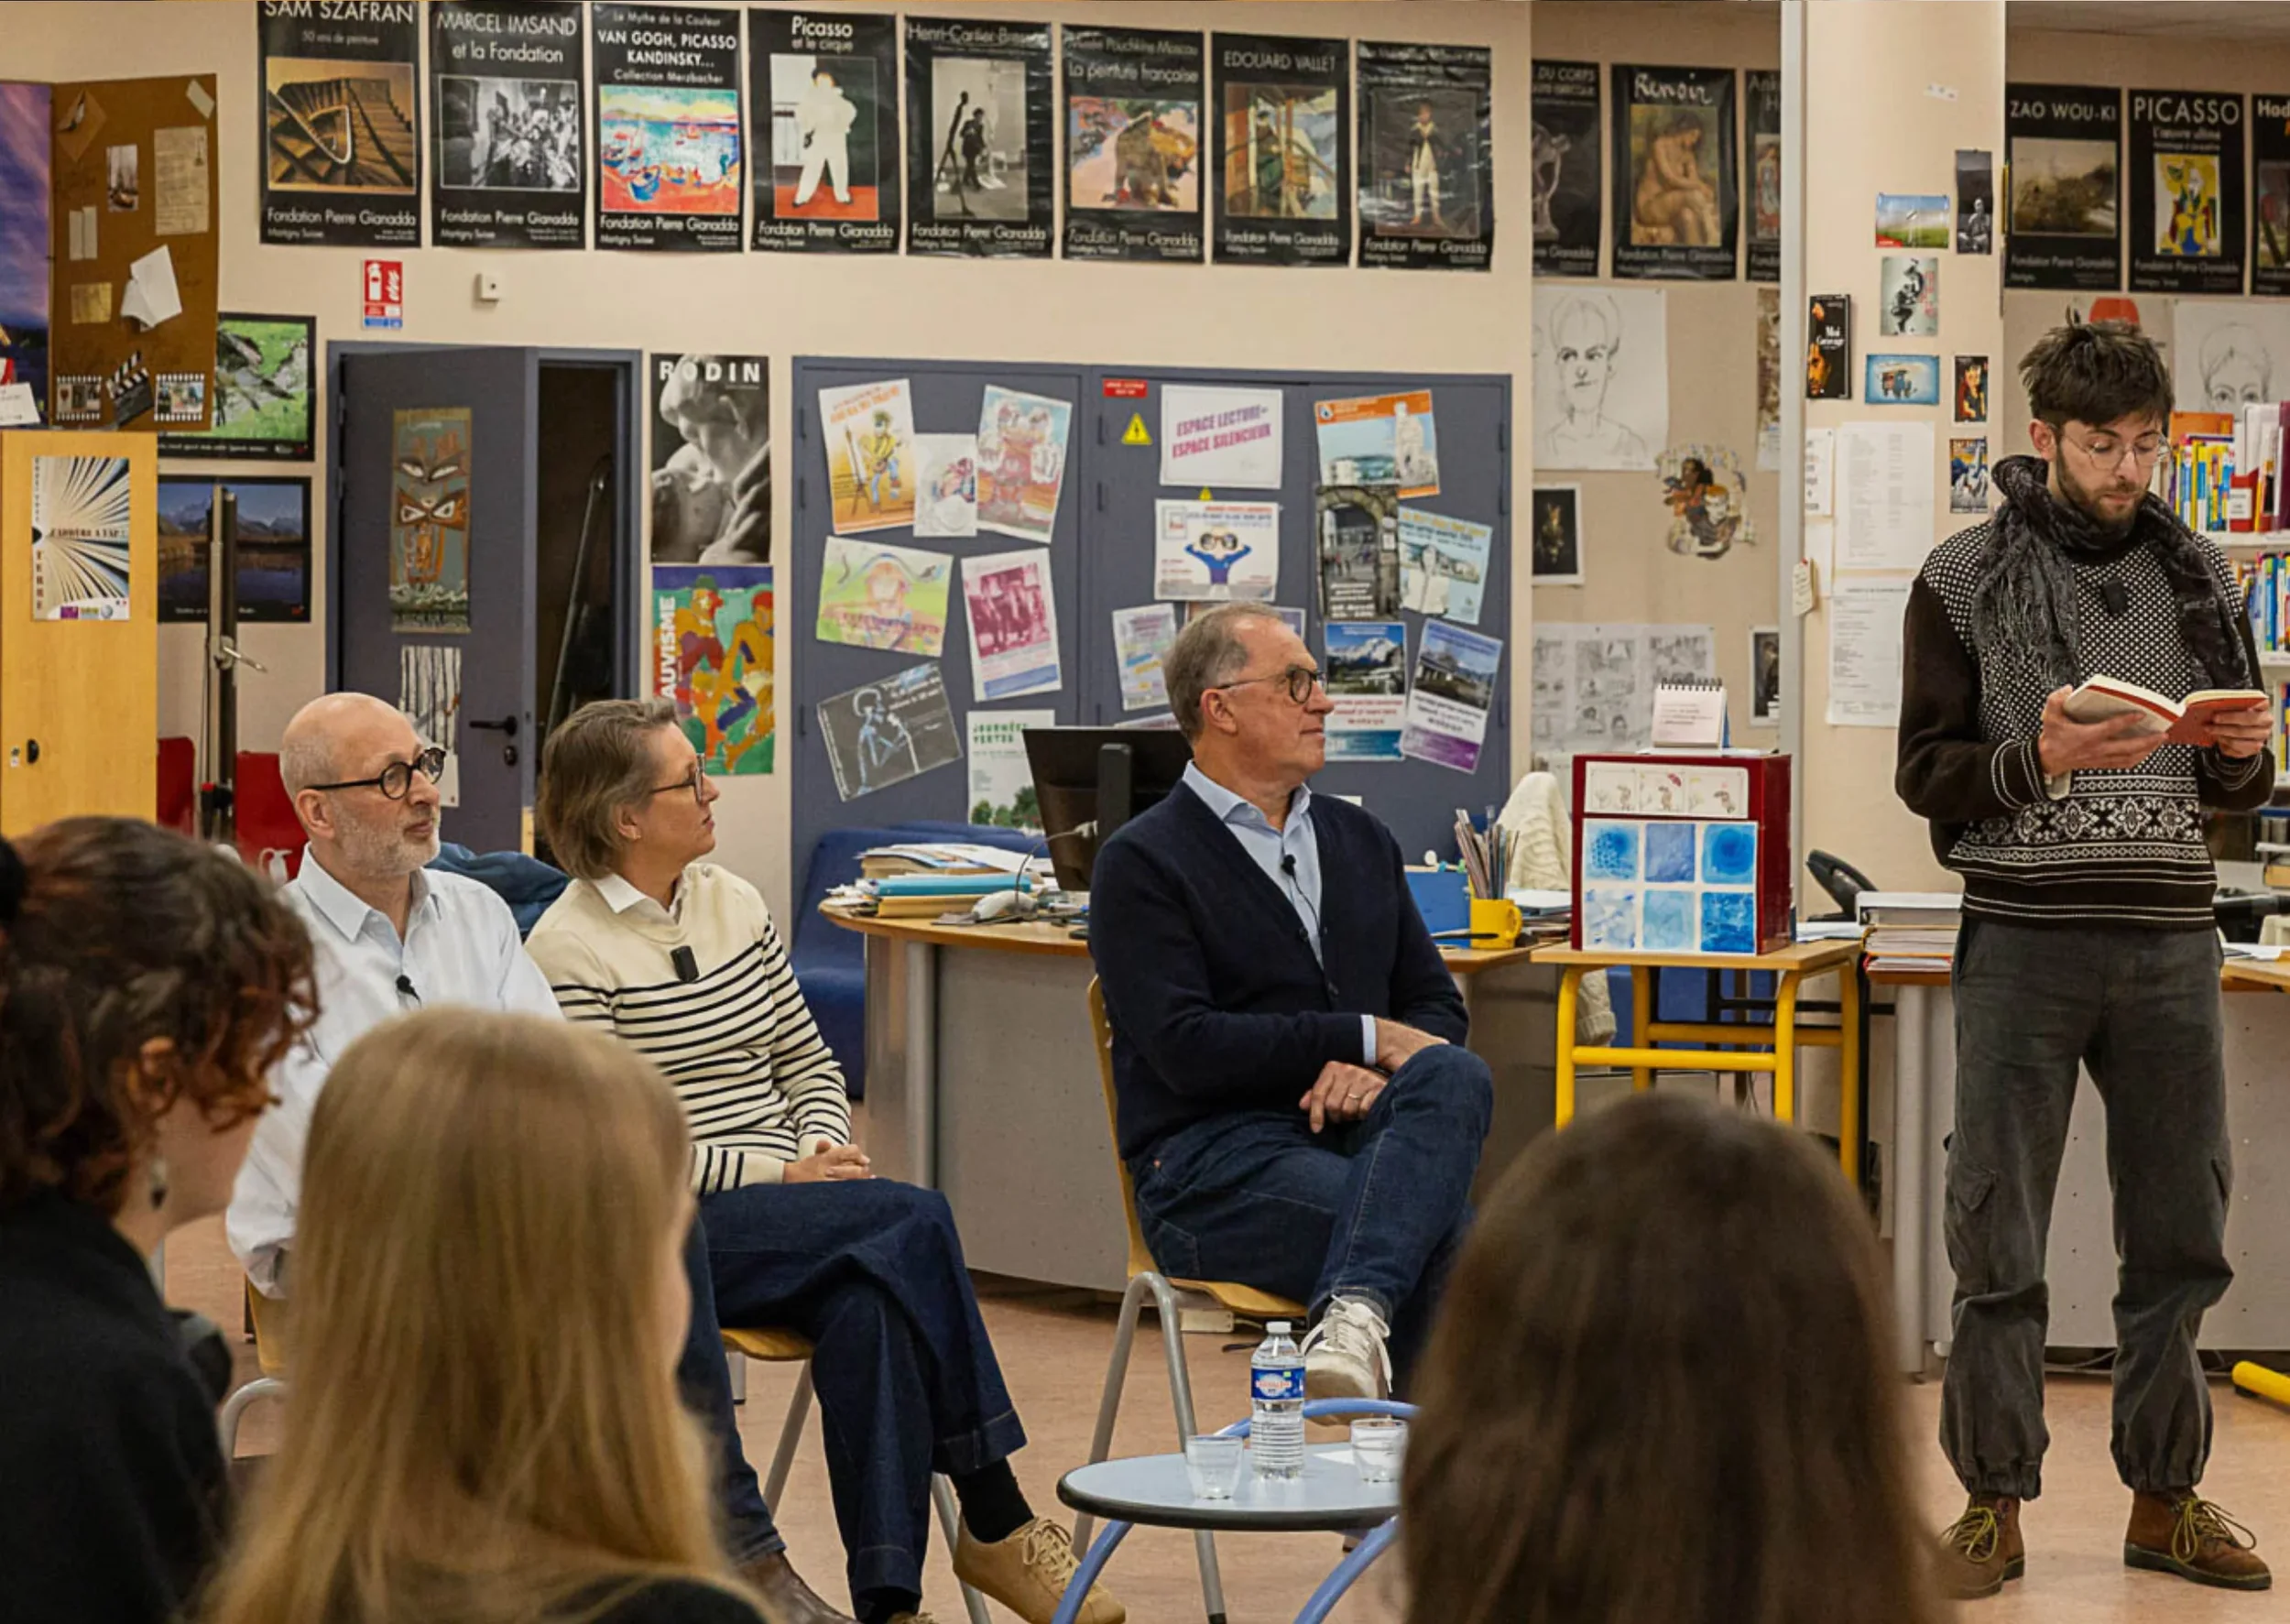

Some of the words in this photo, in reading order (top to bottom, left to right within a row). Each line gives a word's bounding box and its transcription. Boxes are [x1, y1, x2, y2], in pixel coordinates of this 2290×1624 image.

[265, 1, 313, 18] SAM
[320, 1, 414, 24] SZAFRAN
[659, 13, 671, 24] de
[685, 14, 721, 27] Couleur
[437, 12, 505, 35] MARCEL
[507, 16, 577, 38] IMSAND
[791, 16, 853, 38] Picasso
[598, 29, 627, 45] VAN
[681, 33, 736, 50] PICASSO
[820, 39, 854, 53] cirque
[453, 43, 468, 60] et
[471, 41, 485, 60] la
[490, 43, 563, 64] Fondation
[1224, 50, 1291, 71] EDOUARD
[1294, 55, 1336, 71] VALLET
[614, 68, 664, 82] Collection
[1087, 62, 1139, 82] peinture
[1140, 63, 1199, 84] française
[1634, 72, 1712, 104] Renoir
[2010, 100, 2045, 119] ZAO
[2052, 102, 2117, 121] WOU-KI
[2133, 96, 2240, 125] PICASSO
[267, 207, 322, 223] Fondation
[325, 209, 356, 225] Pierre
[359, 209, 416, 226] Gianadda
[441, 210, 492, 224] Fondation
[496, 211, 524, 226] Pierre
[527, 211, 579, 227] Gianadda
[601, 214, 653, 230] Fondation
[656, 216, 684, 231] Pierre
[687, 216, 738, 232] Gianadda
[759, 222, 806, 237] Fondation
[809, 224, 835, 237] Pierre
[840, 223, 894, 238] Gianadda
[912, 223, 960, 237] Fondation
[660, 361, 759, 383] RODIN
[1176, 414, 1216, 438] ESPACE
[1172, 437, 1209, 459] ESPACE
[1213, 423, 1271, 449] SILENCIEUX
[660, 596, 677, 699] AUVISME
